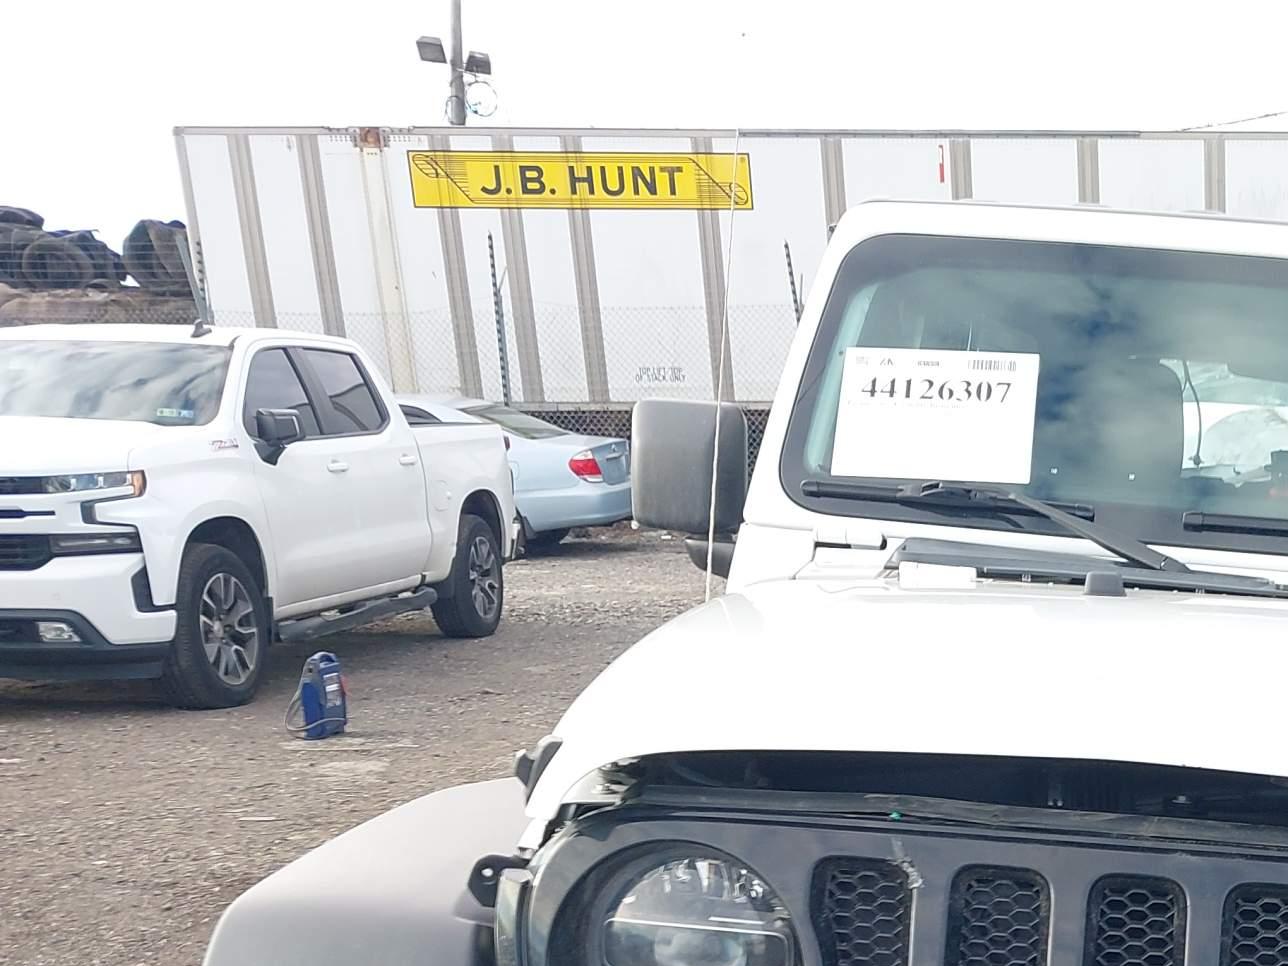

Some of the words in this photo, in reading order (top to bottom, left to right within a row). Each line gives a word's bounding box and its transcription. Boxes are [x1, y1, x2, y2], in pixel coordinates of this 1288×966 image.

[480, 164, 557, 196] J.B.
[567, 164, 684, 197] HUNT
[861, 376, 1012, 403] 44126307
